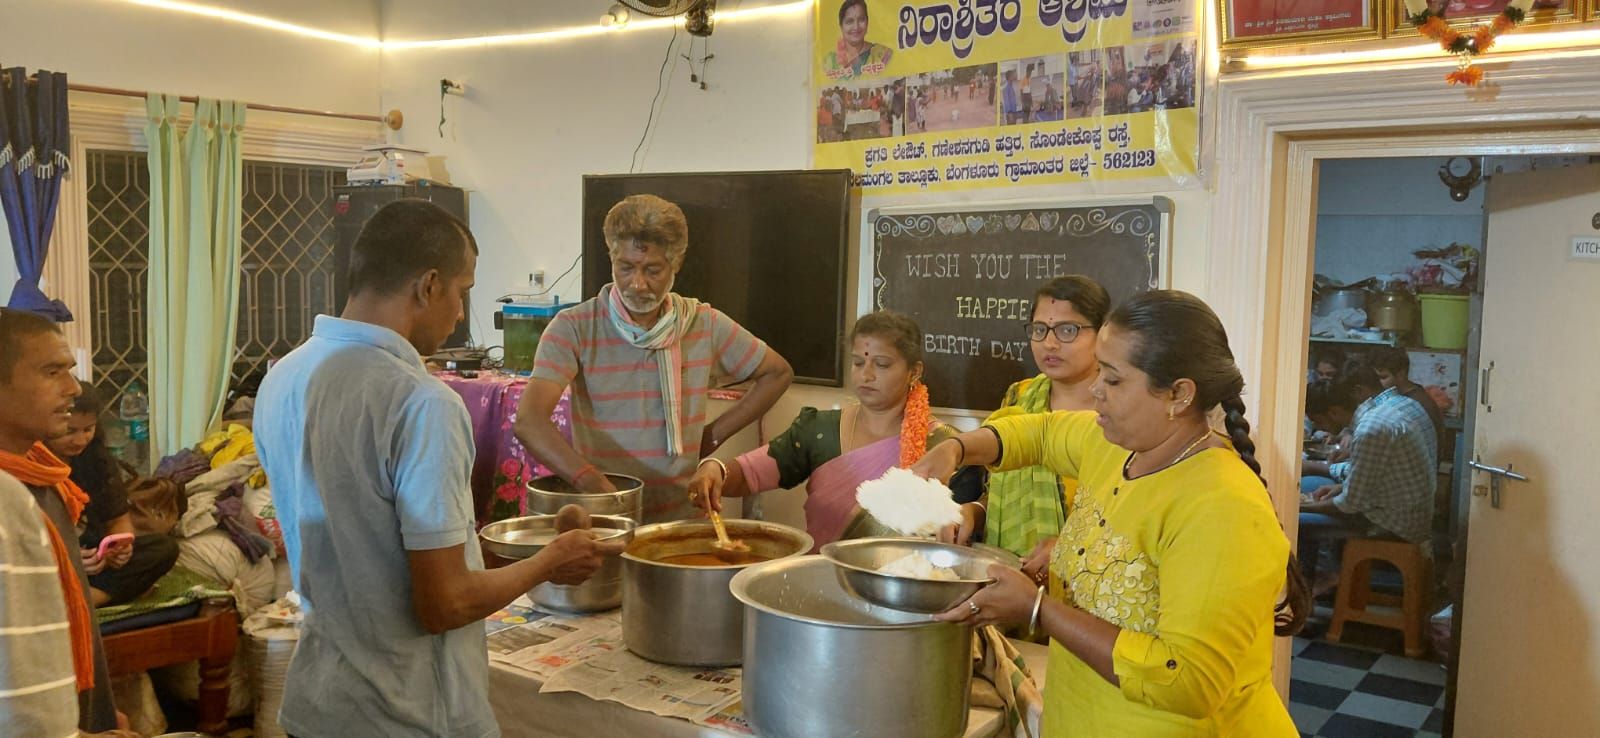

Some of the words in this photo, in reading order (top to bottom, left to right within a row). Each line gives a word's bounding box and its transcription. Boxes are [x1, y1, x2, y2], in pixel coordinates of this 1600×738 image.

[865, 147, 888, 168] ಪ್ರಗತಿ
[946, 161, 999, 181] ಬೆಂಗಳೂರು
[1005, 156, 1063, 182] ಗ್ರಾಮಾಂತರ
[1103, 150, 1155, 170] 562123
[905, 254, 960, 278] WISH
[971, 254, 1013, 280] YOU
[1019, 254, 1067, 280] THE
[956, 296, 1032, 321] HAPPIE
[925, 333, 980, 357] BIRTH
[991, 340, 1028, 362] DAY
